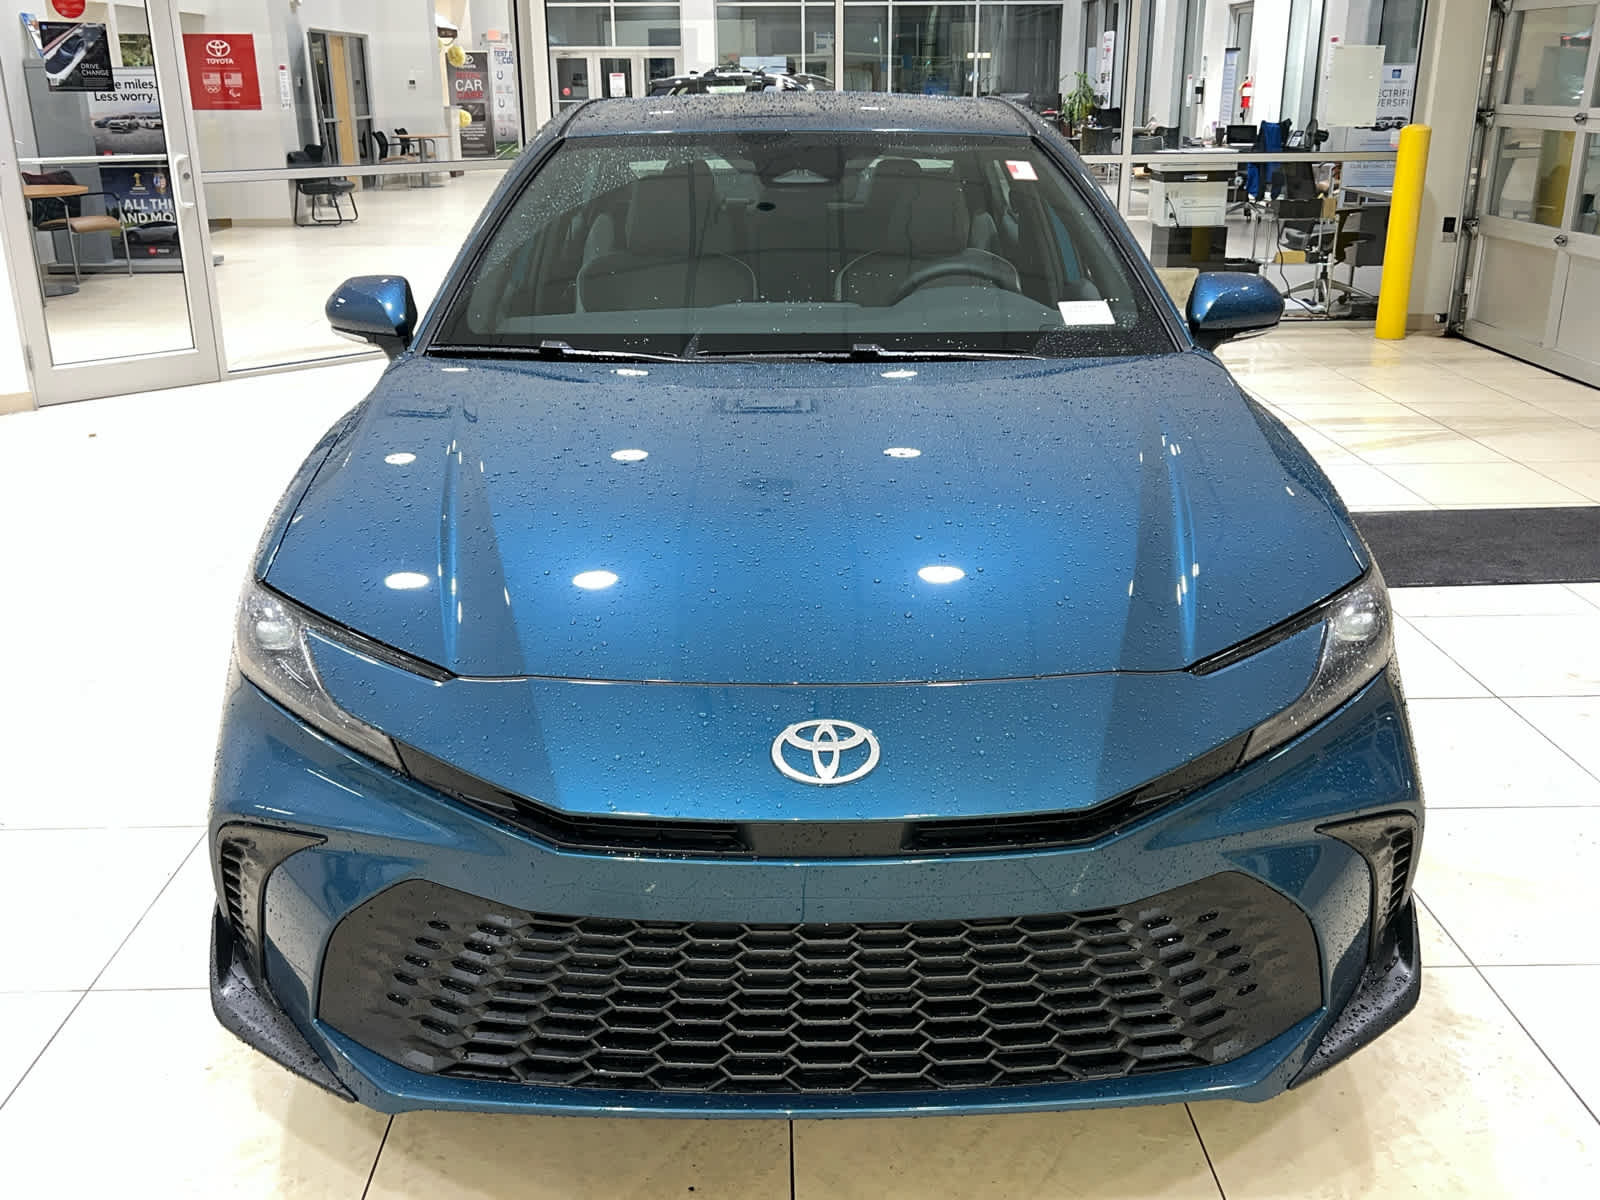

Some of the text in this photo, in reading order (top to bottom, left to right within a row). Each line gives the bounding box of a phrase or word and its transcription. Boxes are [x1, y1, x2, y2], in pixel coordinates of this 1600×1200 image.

[81, 69, 109, 77] CHANGE
[455, 79, 483, 92] CAR
[94, 91, 156, 103] Less worry.
[124, 198, 148, 211] ALL
